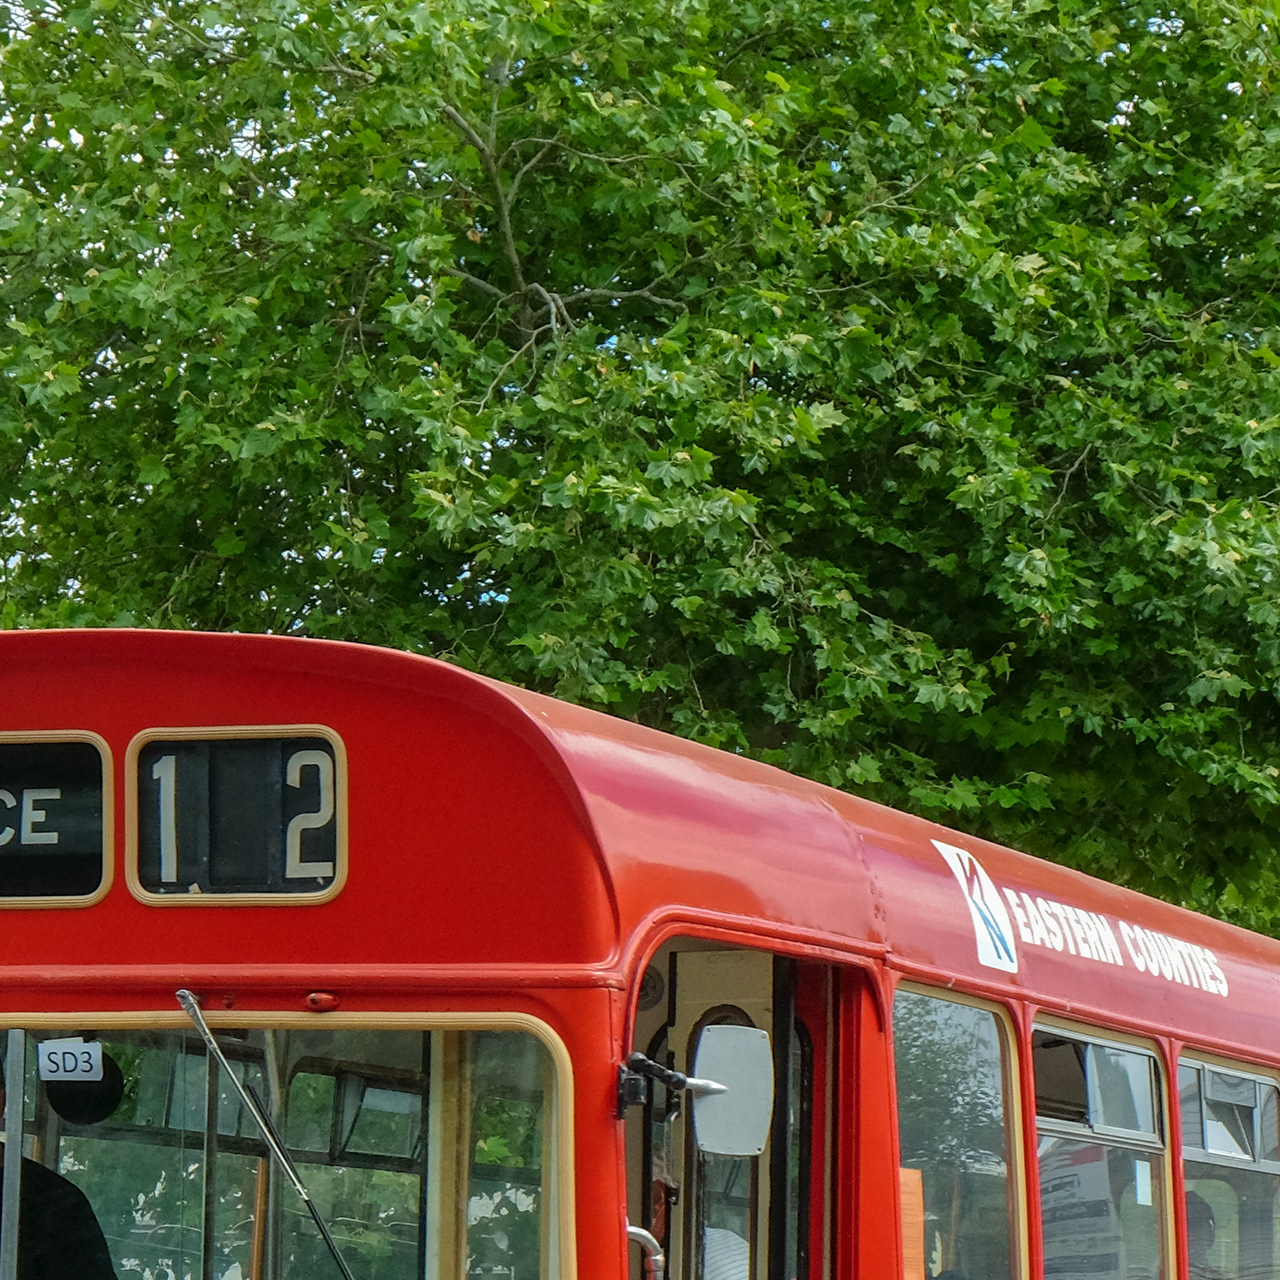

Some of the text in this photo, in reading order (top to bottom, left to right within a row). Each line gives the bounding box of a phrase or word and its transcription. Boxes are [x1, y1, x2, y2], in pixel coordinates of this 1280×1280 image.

[1002, 887, 1229, 998] EASTERN COUNTIES
[47, 1051, 94, 1074] SD3
